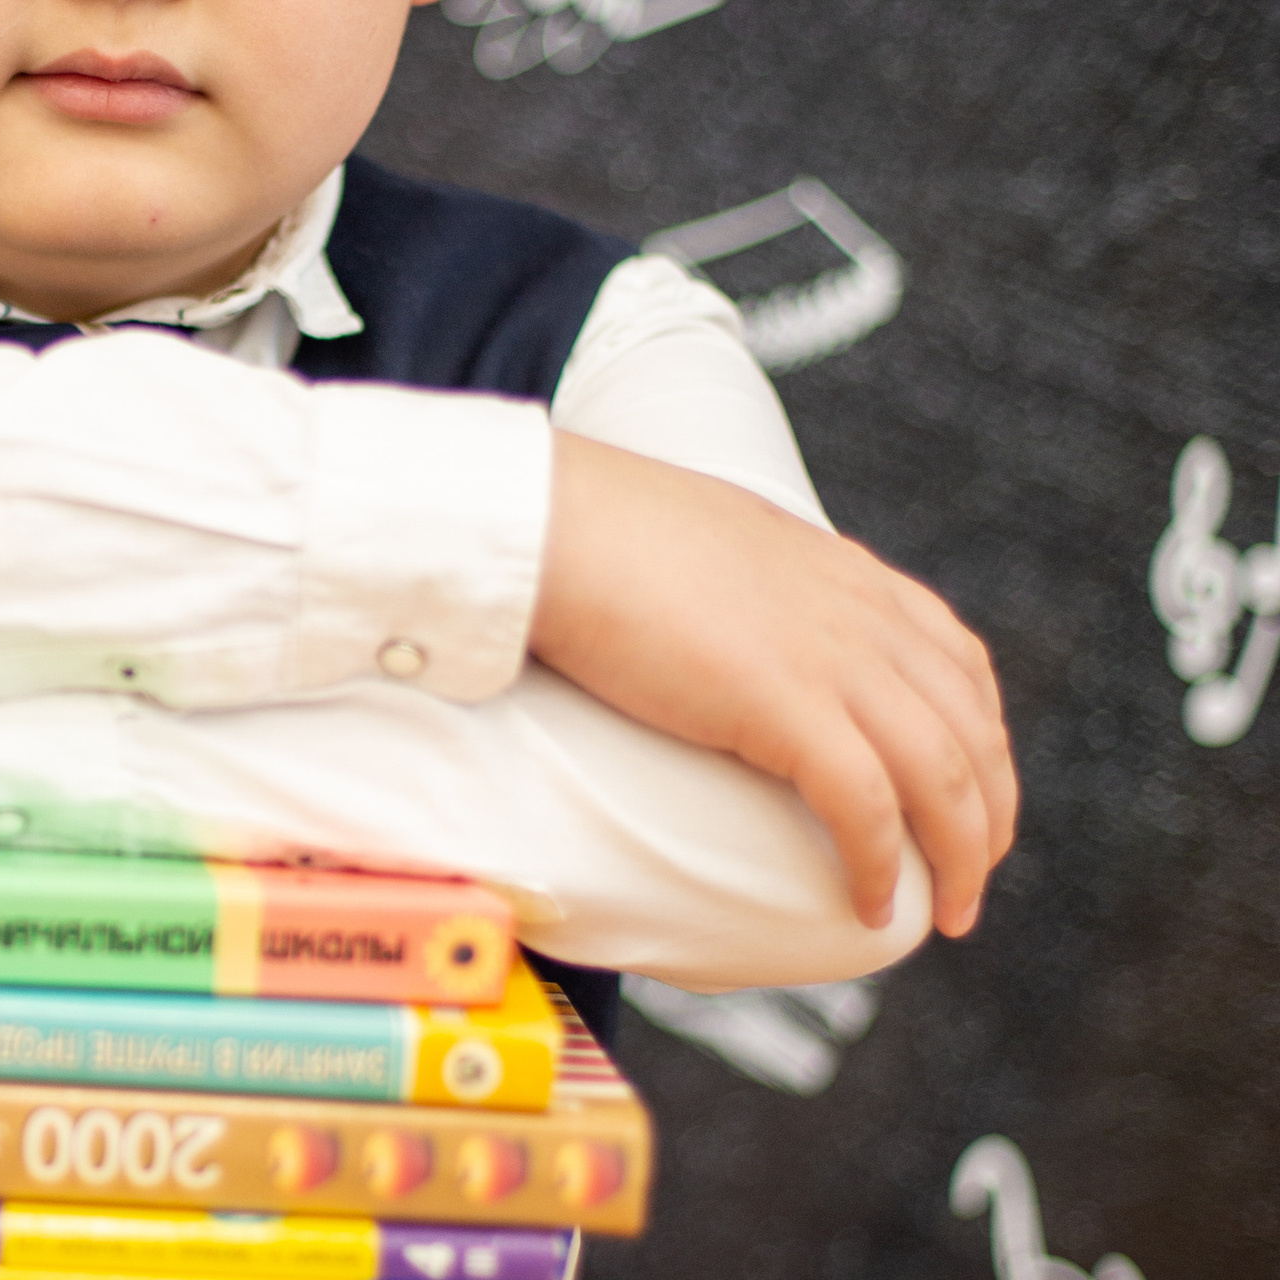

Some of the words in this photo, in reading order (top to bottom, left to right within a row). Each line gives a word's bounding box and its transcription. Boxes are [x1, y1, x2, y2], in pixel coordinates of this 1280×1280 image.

[261, 926, 407, 967] ШКОЛЫ
[92, 1030, 204, 1076] ГРУППЕ
[214, 1035, 239, 1075] В
[245, 1039, 386, 1085] ЗАНЯТИЯ
[21, 1105, 227, 1189] 2000
